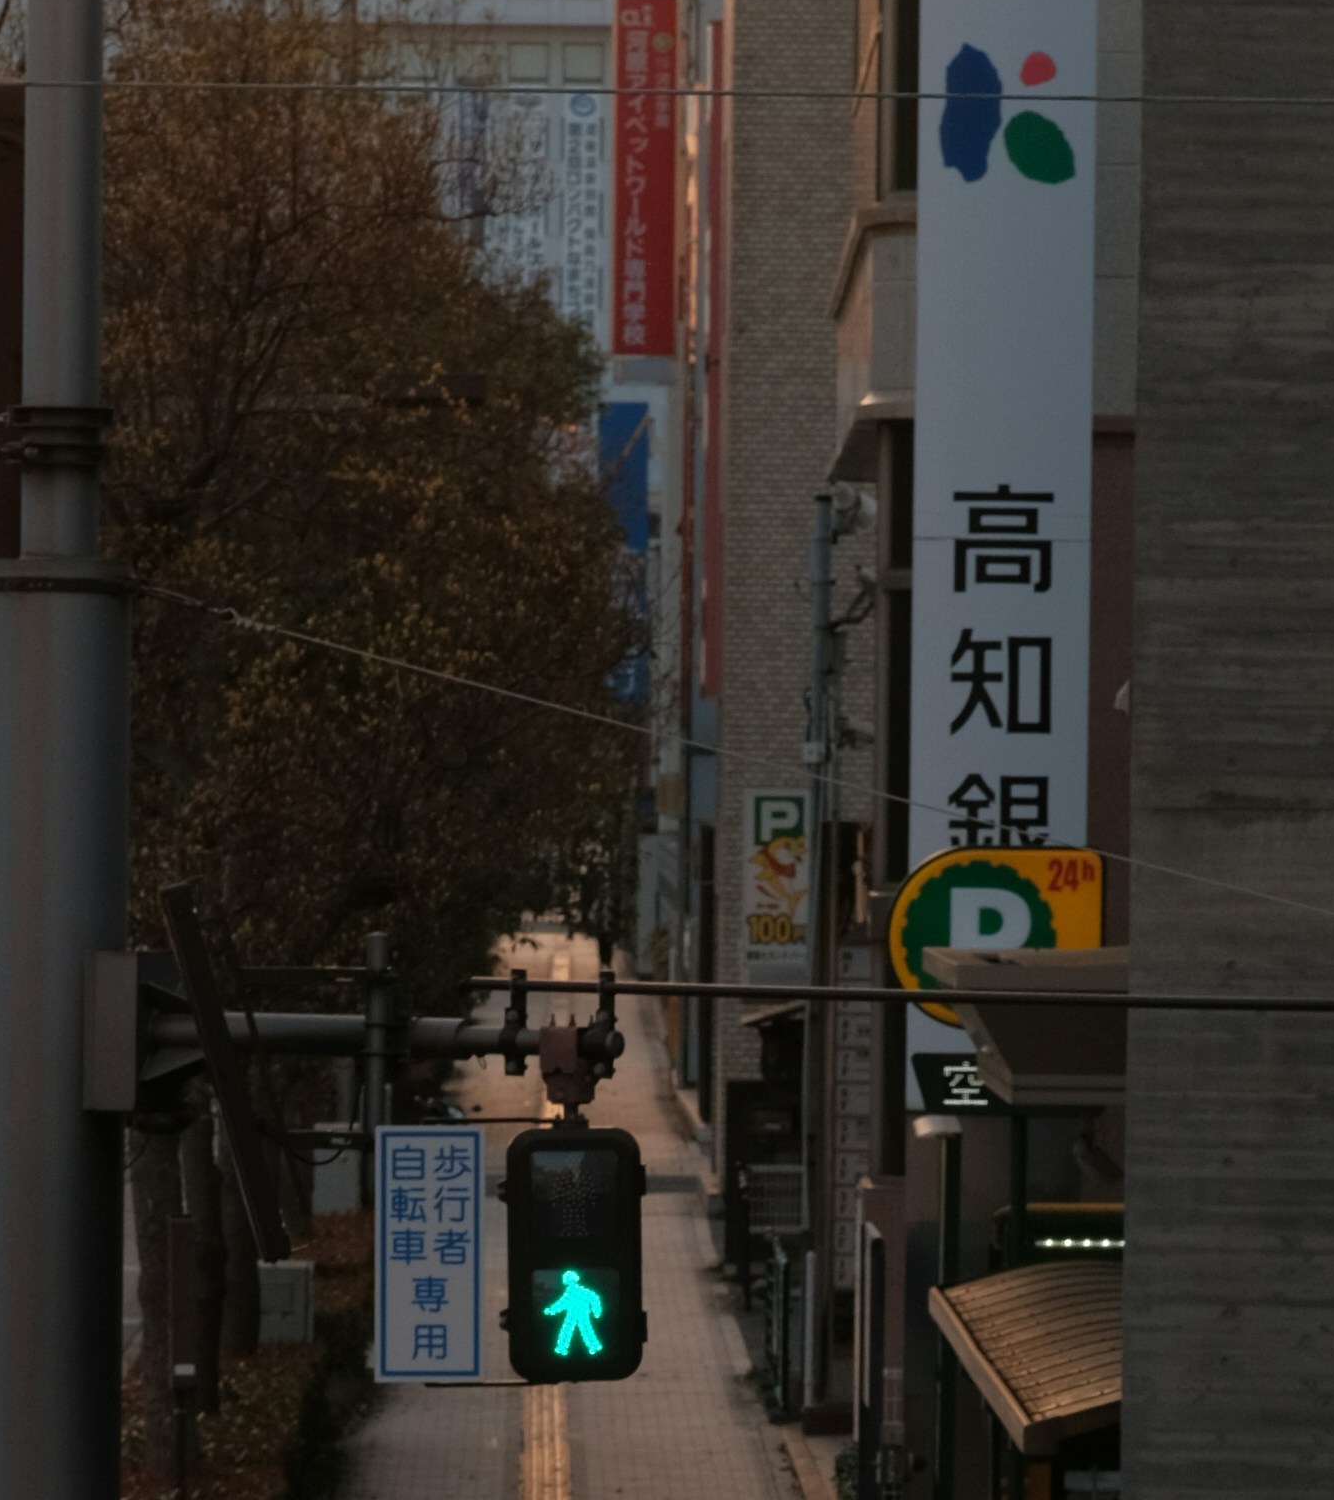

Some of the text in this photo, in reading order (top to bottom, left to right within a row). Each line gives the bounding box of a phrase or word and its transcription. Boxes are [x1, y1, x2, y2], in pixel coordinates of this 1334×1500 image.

[760, 800, 801, 842] P
[1047, 857, 1095, 894] 24h
[948, 887, 1033, 948] P
[390, 1145, 427, 1264] 自転車
[433, 1144, 472, 1265] 歩行者
[411, 1276, 449, 1361] 専用
